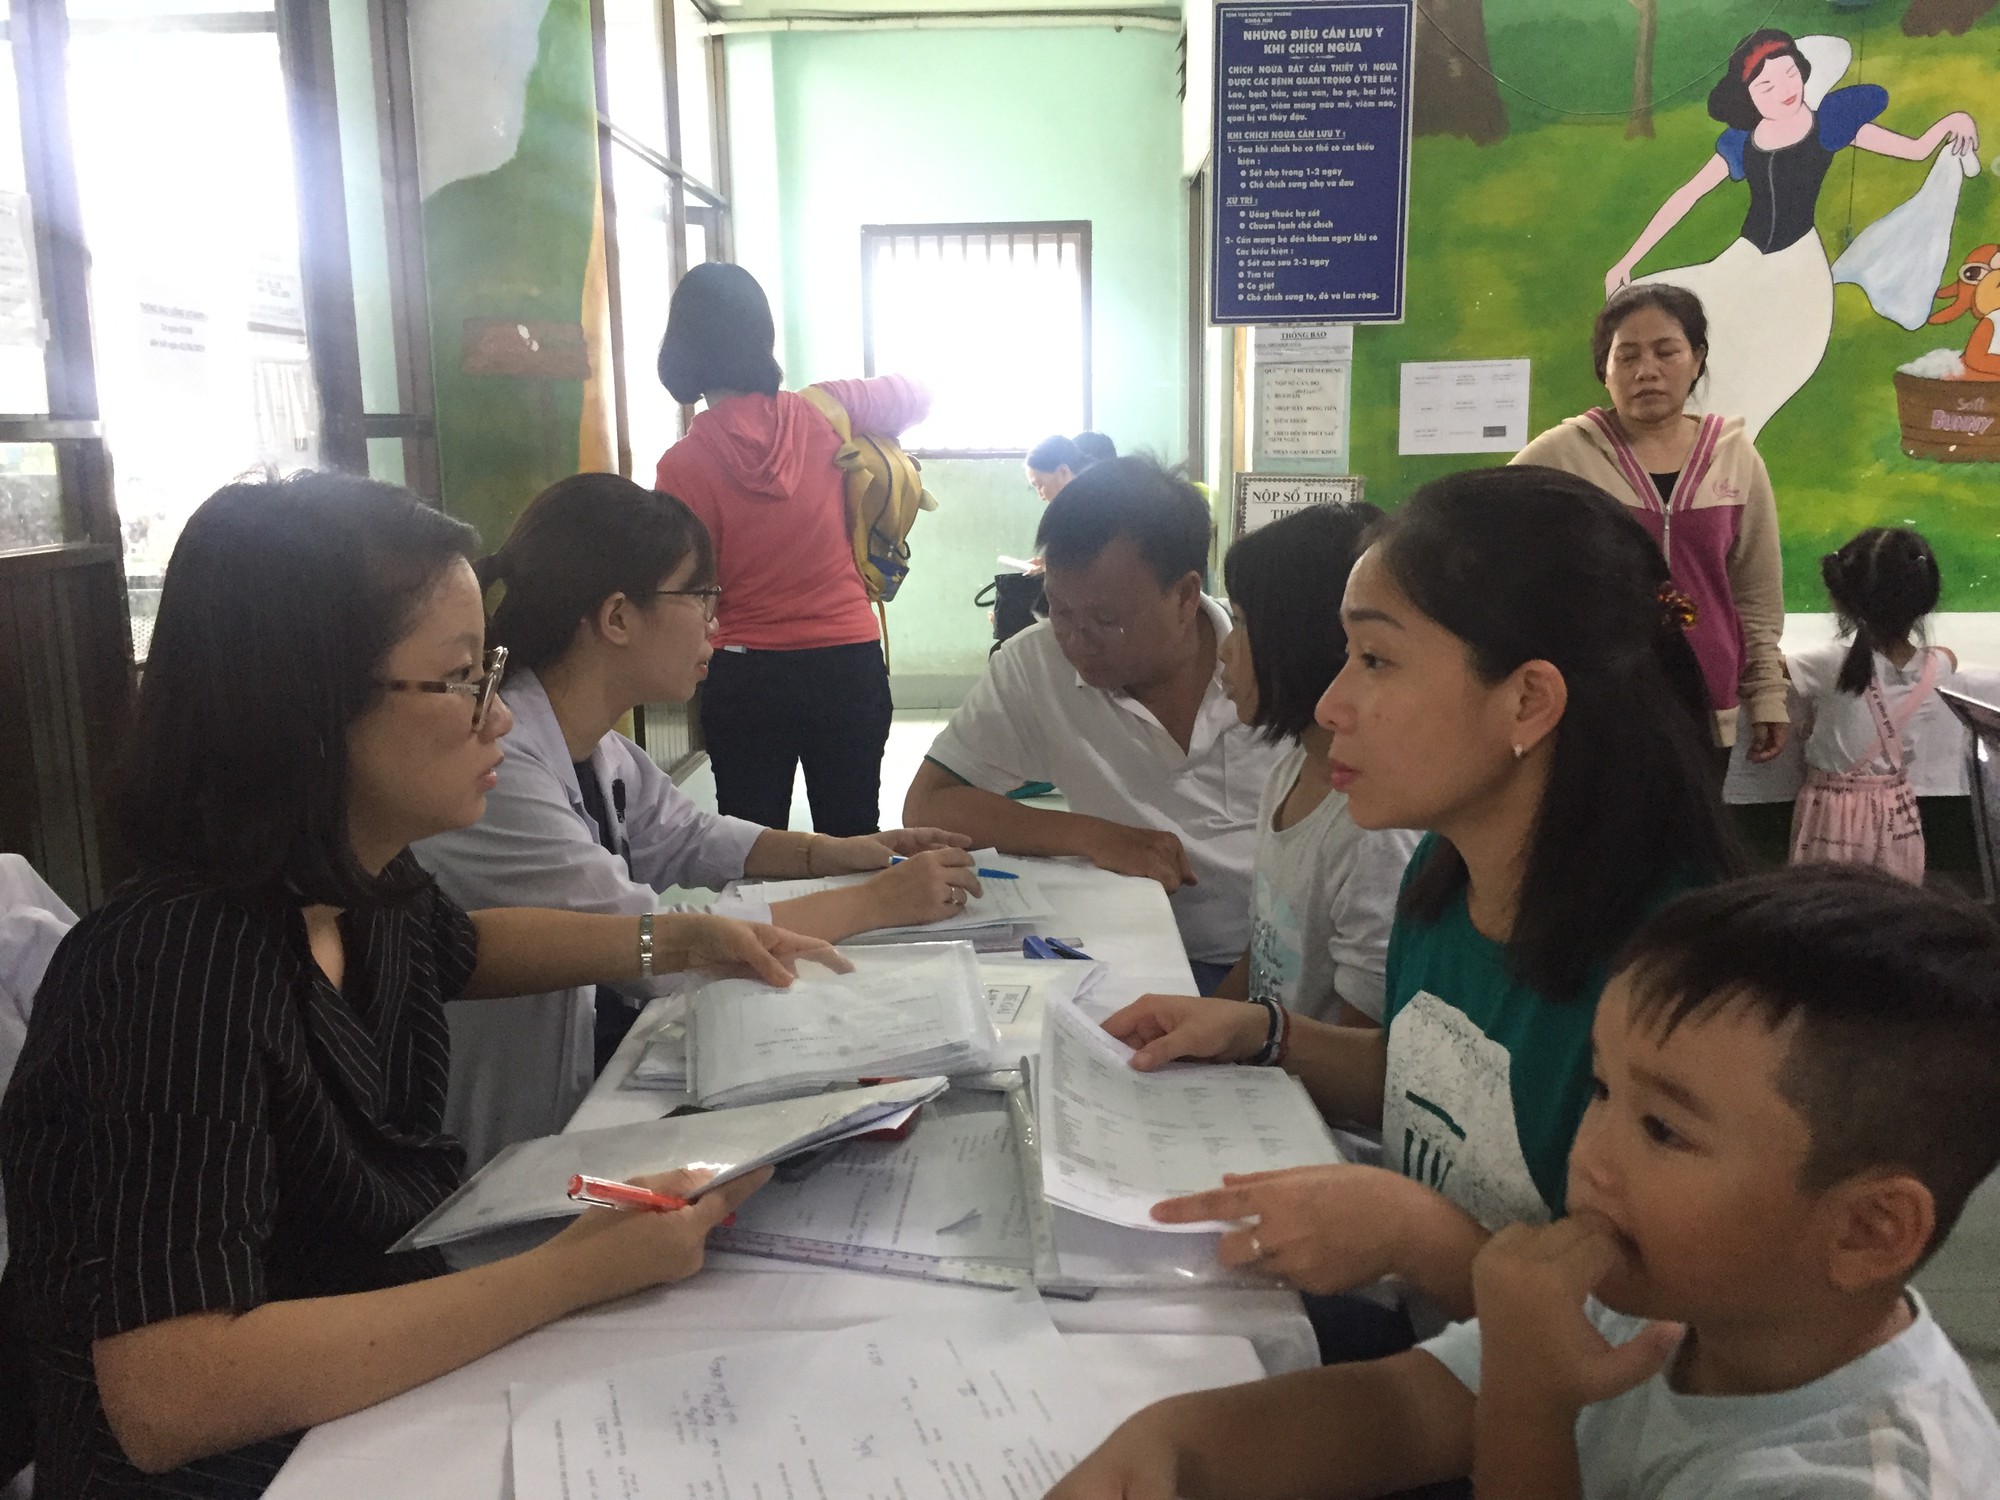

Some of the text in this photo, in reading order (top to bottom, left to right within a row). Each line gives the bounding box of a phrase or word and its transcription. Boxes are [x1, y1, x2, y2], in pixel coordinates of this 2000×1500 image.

[1243, 26, 1384, 41] NHỮNG ĐIỀU CẦN LƯU Ý
[1264, 41, 1362, 54] KHI CHÍCH NGỪA
[1296, 76, 1320, 85] QUAN
[1322, 76, 1352, 86] TRỌNG
[1379, 75, 1392, 83] EM
[1228, 90, 1245, 99] Lao,
[1332, 87, 1343, 96] ho
[1226, 114, 1245, 124] quai
[1227, 131, 1242, 140] KHI
[1237, 145, 1253, 153] Sau
[1255, 144, 1268, 153] khi
[1281, 168, 1303, 178] trong
[1353, 233, 1367, 242] khi
[1262, 259, 1275, 267] cao
[1293, 258, 1308, 266] 2-3
[1246, 282, 1257, 290] Co
[1305, 293, 1317, 302] to,
[1342, 291, 1356, 299] lan
[1280, 331, 1327, 340] THÔNG BÁO
[1252, 489, 1280, 503] NỘP
[1283, 487, 1300, 502] SỔ
